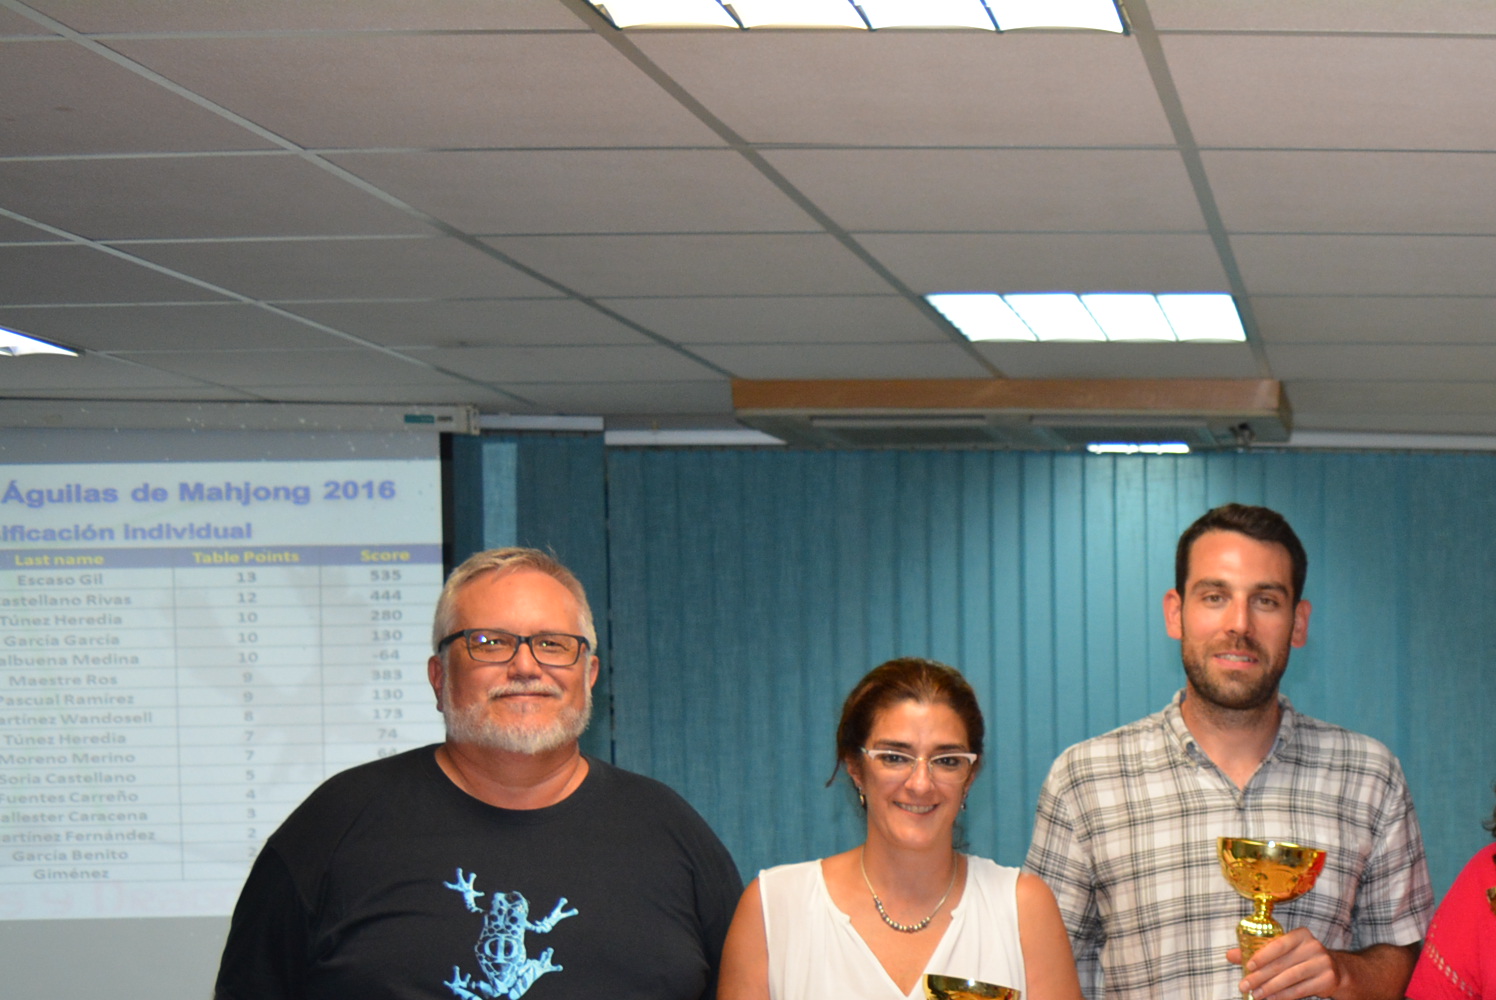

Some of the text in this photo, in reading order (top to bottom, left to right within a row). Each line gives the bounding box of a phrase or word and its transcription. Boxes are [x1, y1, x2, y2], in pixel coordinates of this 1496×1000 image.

[1, 479, 396, 509] Águilas de Mahjong 2016
[0, 524, 115, 542] ificación
[14, 554, 104, 566] Last name
[193, 551, 300, 564] Table Points
[360, 550, 411, 561] Score
[17, 573, 103, 586] Escaso Gil
[237, 572, 257, 583] 13
[370, 570, 402, 582] 535
[0, 594, 132, 607] astellano Rivas
[237, 592, 257, 604] 12
[370, 590, 402, 601] 444
[54, 614, 123, 626] Heredia
[238, 612, 258, 623] 10
[370, 610, 402, 621] 280
[3, 634, 120, 647] García García
[238, 632, 259, 644] 10
[371, 630, 403, 641] 130
[0, 653, 139, 667] albuena Medina
[238, 652, 259, 663] 10
[372, 650, 400, 660] -64
[8, 674, 118, 687] Maestre Ros
[64, 693, 135, 705] Ramírez
[372, 689, 403, 700] 130
[0, 712, 153, 726] artínez Wandosell
[372, 709, 403, 719] 173
[59, 732, 127, 744] Heredia
[244, 731, 254, 742] 7
[377, 728, 398, 739] 74
[72, 752, 136, 764] Merino
[245, 750, 255, 761] 7
[0, 771, 136, 785] Soria Castellano
[245, 770, 255, 781] 5
[69, 791, 139, 803] Carreño
[245, 789, 256, 800] 4
[0, 811, 148, 824] allester Caracena
[0, 830, 156, 844] artínez Fernández
[247, 828, 257, 839] 2
[12, 850, 129, 862] García Benito
[33, 868, 110, 880] Giménez
